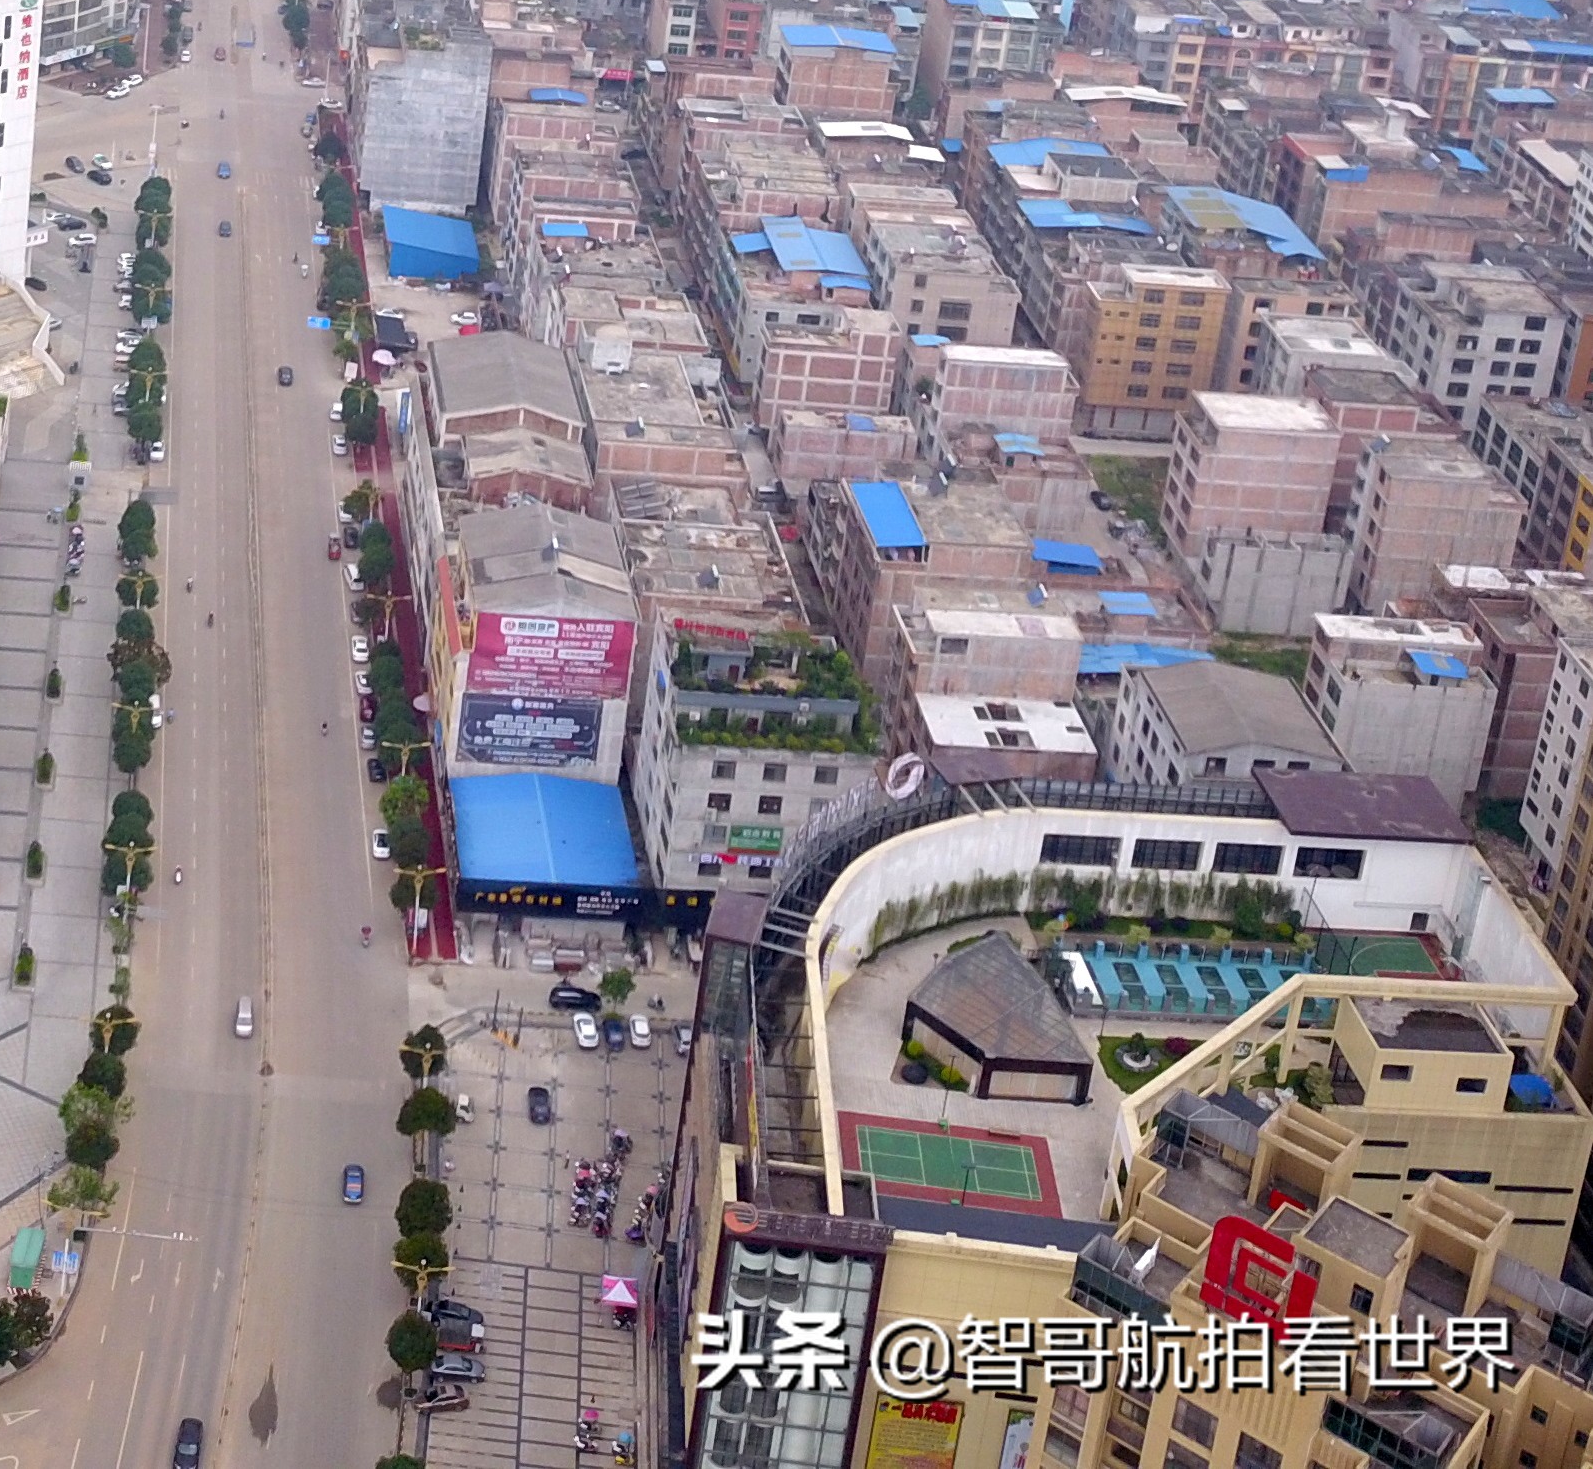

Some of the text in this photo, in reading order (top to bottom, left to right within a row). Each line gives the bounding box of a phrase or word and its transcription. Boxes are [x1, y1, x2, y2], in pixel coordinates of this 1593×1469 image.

[16, 14, 33, 100] 维也纳酒店
